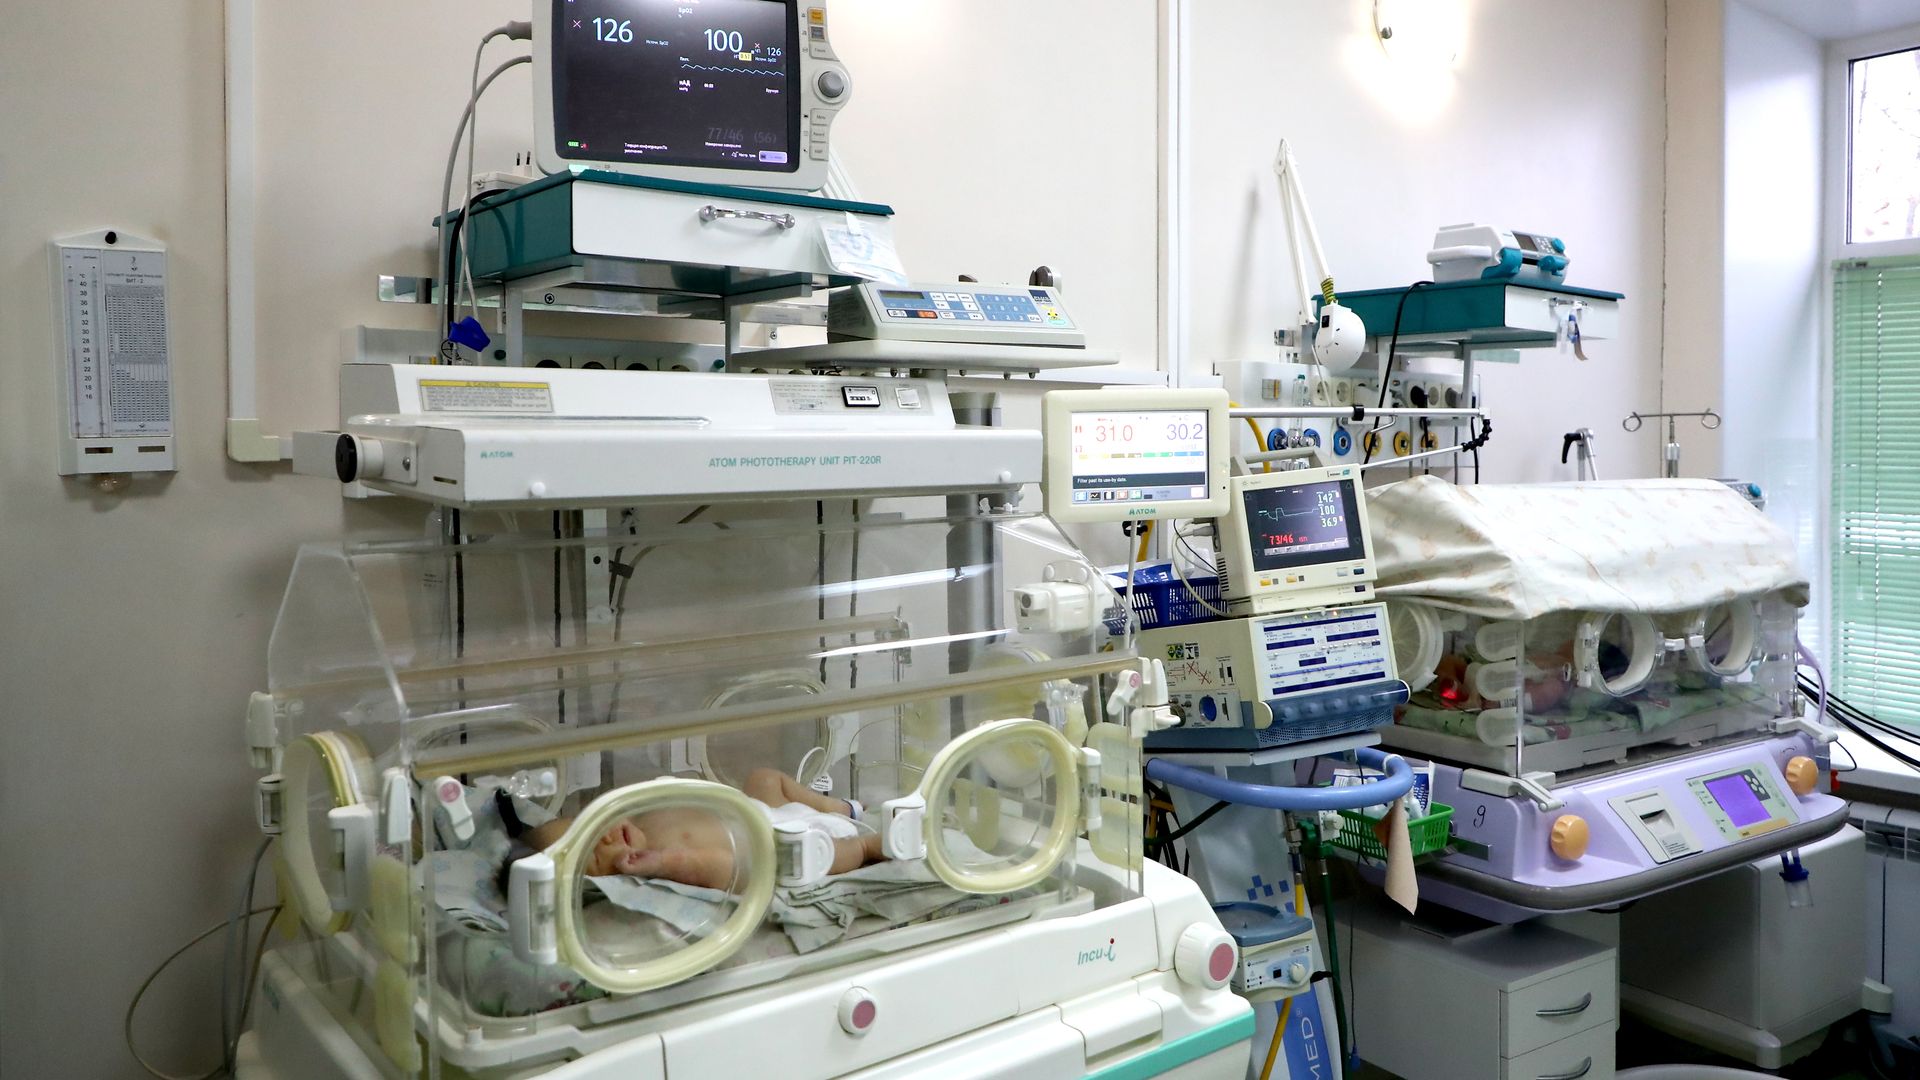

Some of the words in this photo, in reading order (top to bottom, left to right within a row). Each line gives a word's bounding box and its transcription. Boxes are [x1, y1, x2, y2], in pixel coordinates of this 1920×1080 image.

[592, 17, 633, 43] 126
[704, 28, 743, 53] 100
[766, 46, 782, 57] 126
[1167, 424, 1203, 440] 30.2
[709, 458, 737, 467] ATOM
[740, 457, 816, 467] PHOTOTHERAPY
[820, 456, 839, 465] UNIT
[843, 455, 882, 465] PIT-220R
[1318, 494, 1334, 503] 142
[1320, 505, 1335, 515] 100
[1321, 516, 1338, 527] 36.9
[1269, 534, 1294, 545] 73/46
[1473, 805, 1487, 828] 9
